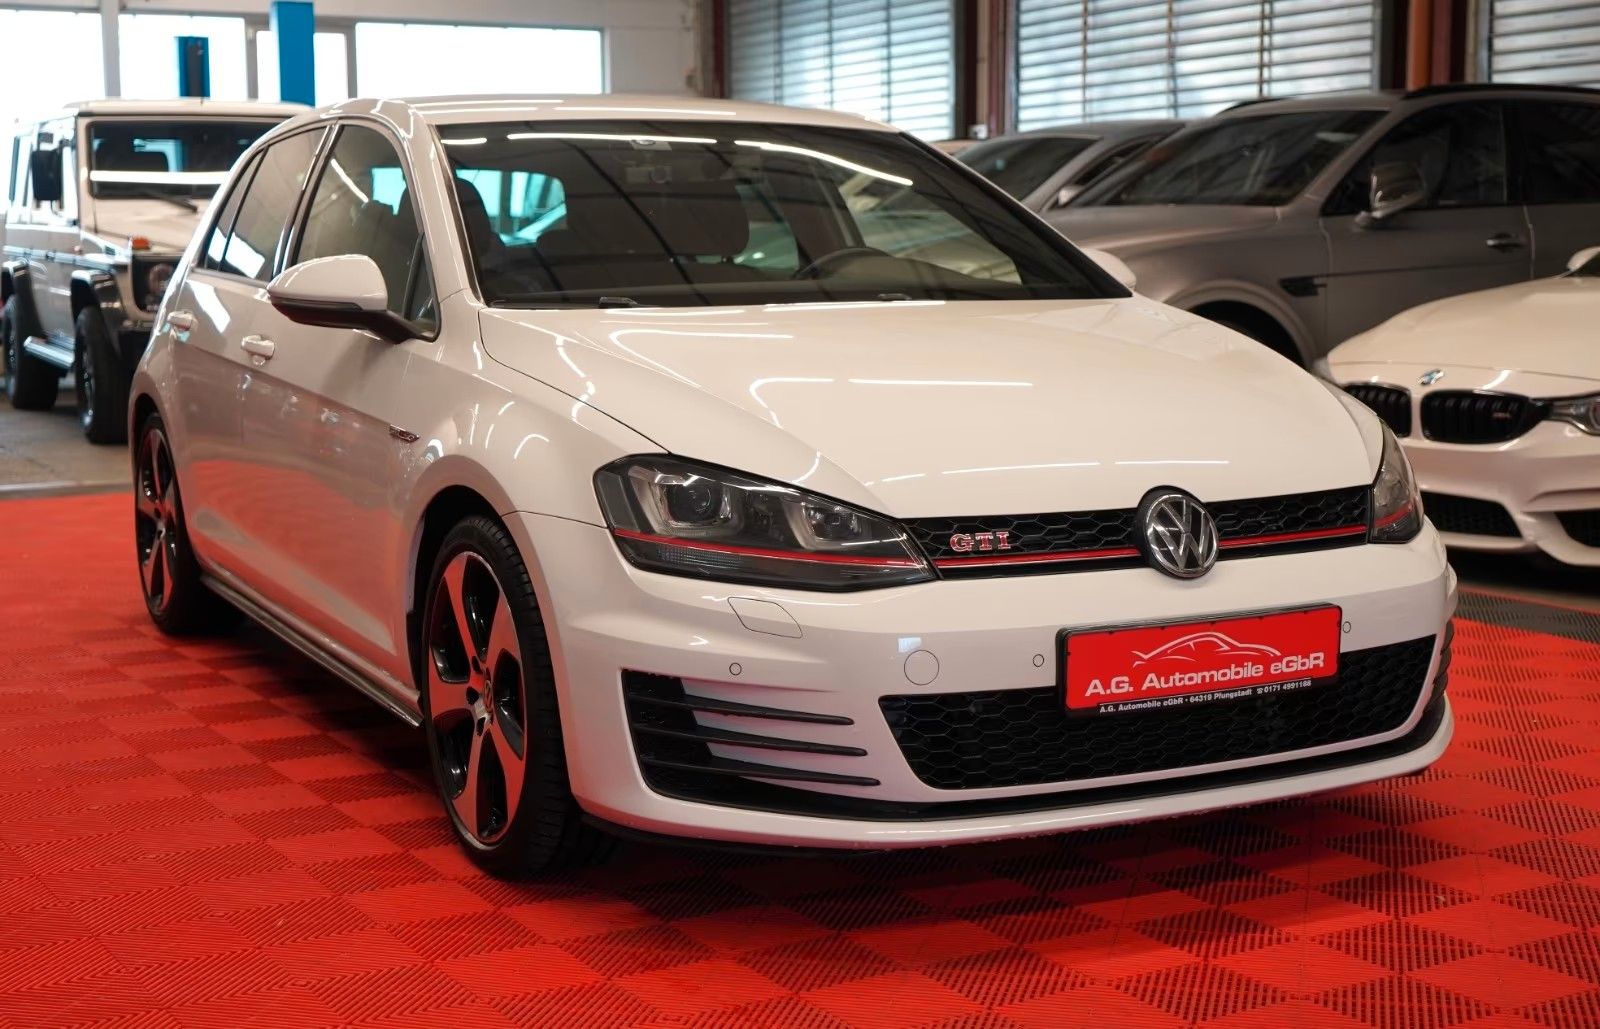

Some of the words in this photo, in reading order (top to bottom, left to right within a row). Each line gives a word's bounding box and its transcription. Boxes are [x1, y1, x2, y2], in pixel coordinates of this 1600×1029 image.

[950, 531, 1011, 552] GTI
[1085, 676, 1134, 696] A.G.
[1141, 662, 1264, 691] Automobile
[1270, 652, 1324, 674] eGbR
[1118, 701, 1161, 711] Automobile
[1163, 698, 1184, 706] eGbR
